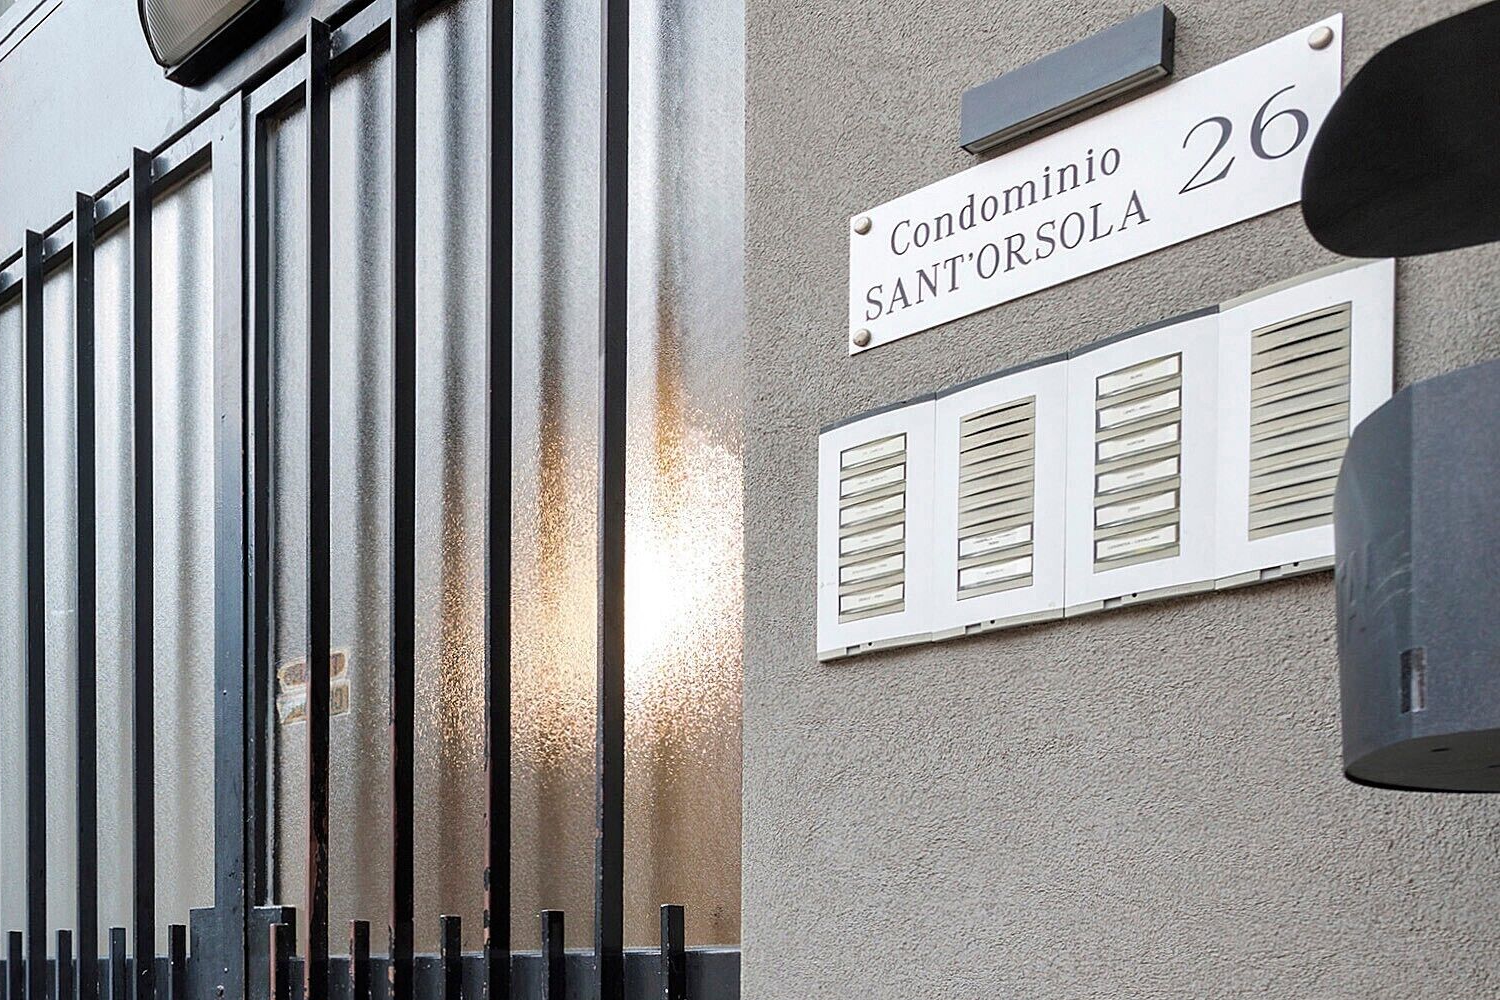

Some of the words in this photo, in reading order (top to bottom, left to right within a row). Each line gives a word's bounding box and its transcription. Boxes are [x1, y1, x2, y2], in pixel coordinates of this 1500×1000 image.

[1179, 85, 1308, 195] 26
[865, 189, 1151, 321] SANT'ORSOLA
[890, 147, 1121, 256] Condominio
